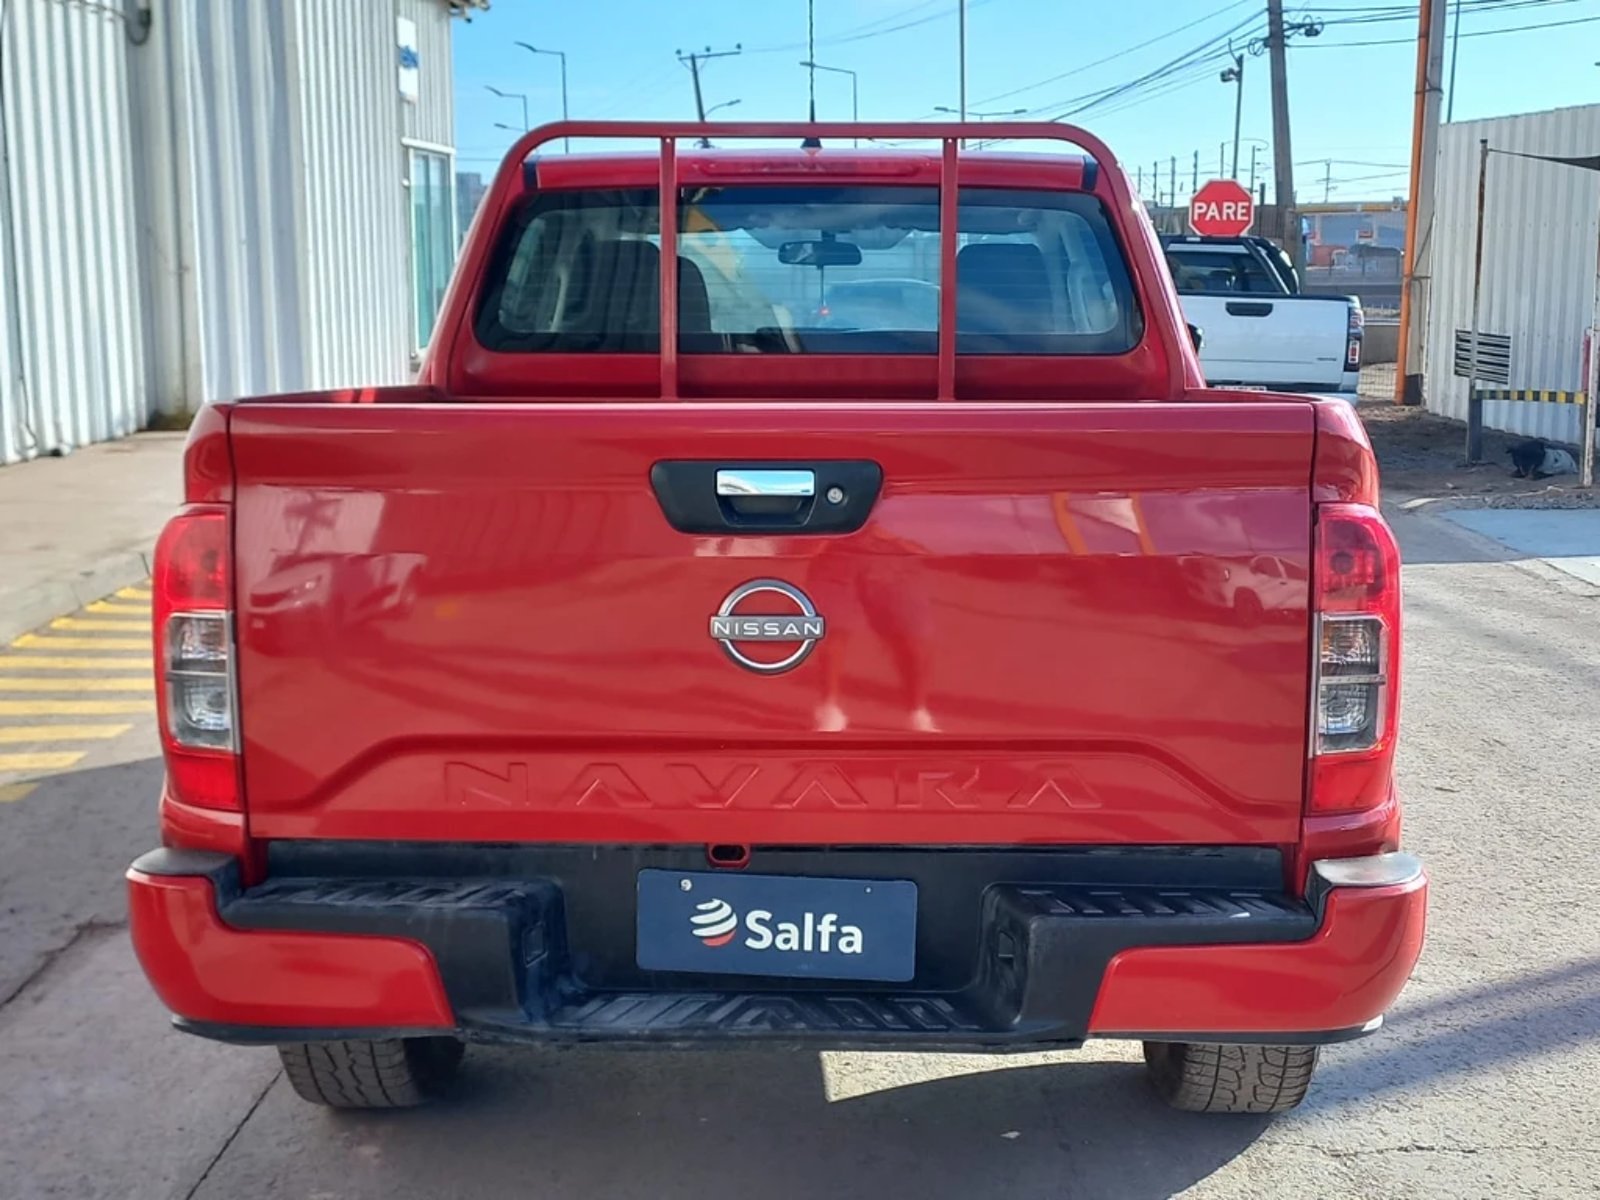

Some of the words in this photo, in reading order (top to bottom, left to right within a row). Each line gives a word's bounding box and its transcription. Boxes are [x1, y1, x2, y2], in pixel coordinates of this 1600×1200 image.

[1192, 201, 1250, 222] PARE
[713, 621, 821, 636] NISSAN
[444, 761, 1103, 809] NAVARA
[744, 909, 864, 955] Salfa
